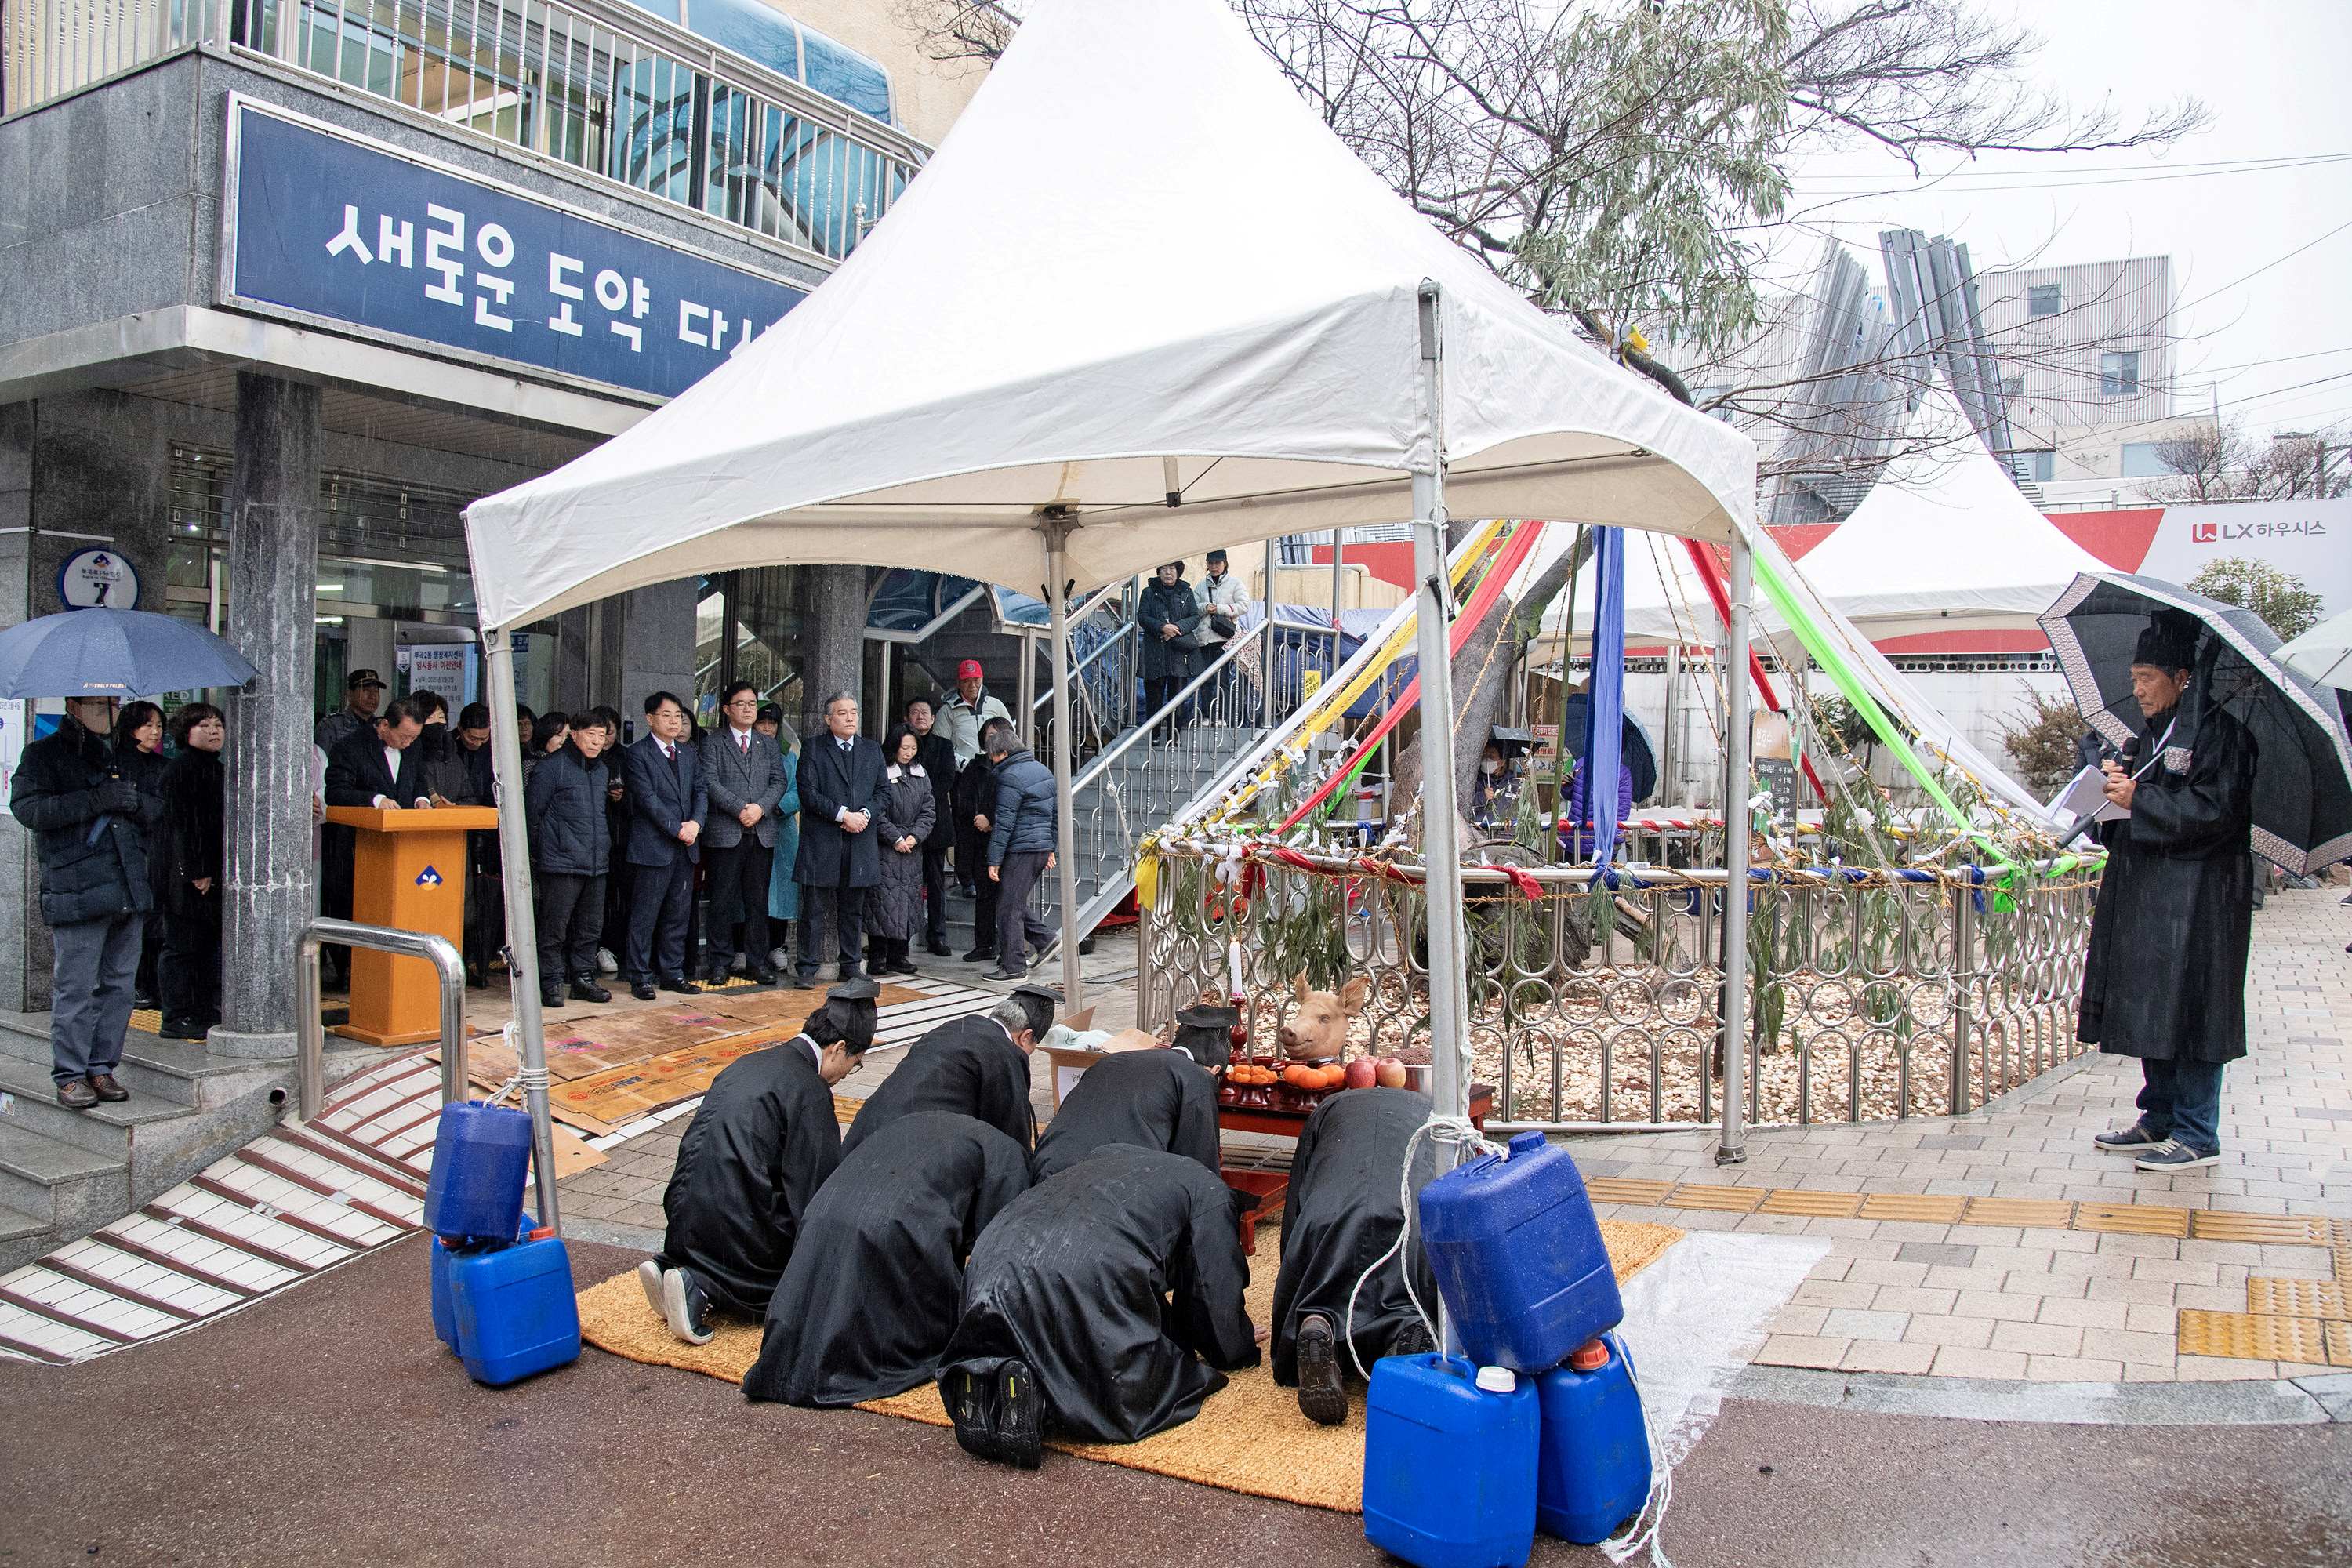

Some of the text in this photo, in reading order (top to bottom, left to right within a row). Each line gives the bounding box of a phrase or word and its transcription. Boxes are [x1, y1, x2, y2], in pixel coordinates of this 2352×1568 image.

[325, 202, 514, 332] 새로운
[549, 252, 650, 352] 도약
[93, 583, 111, 604] 7
[164, 691, 190, 700] AED
